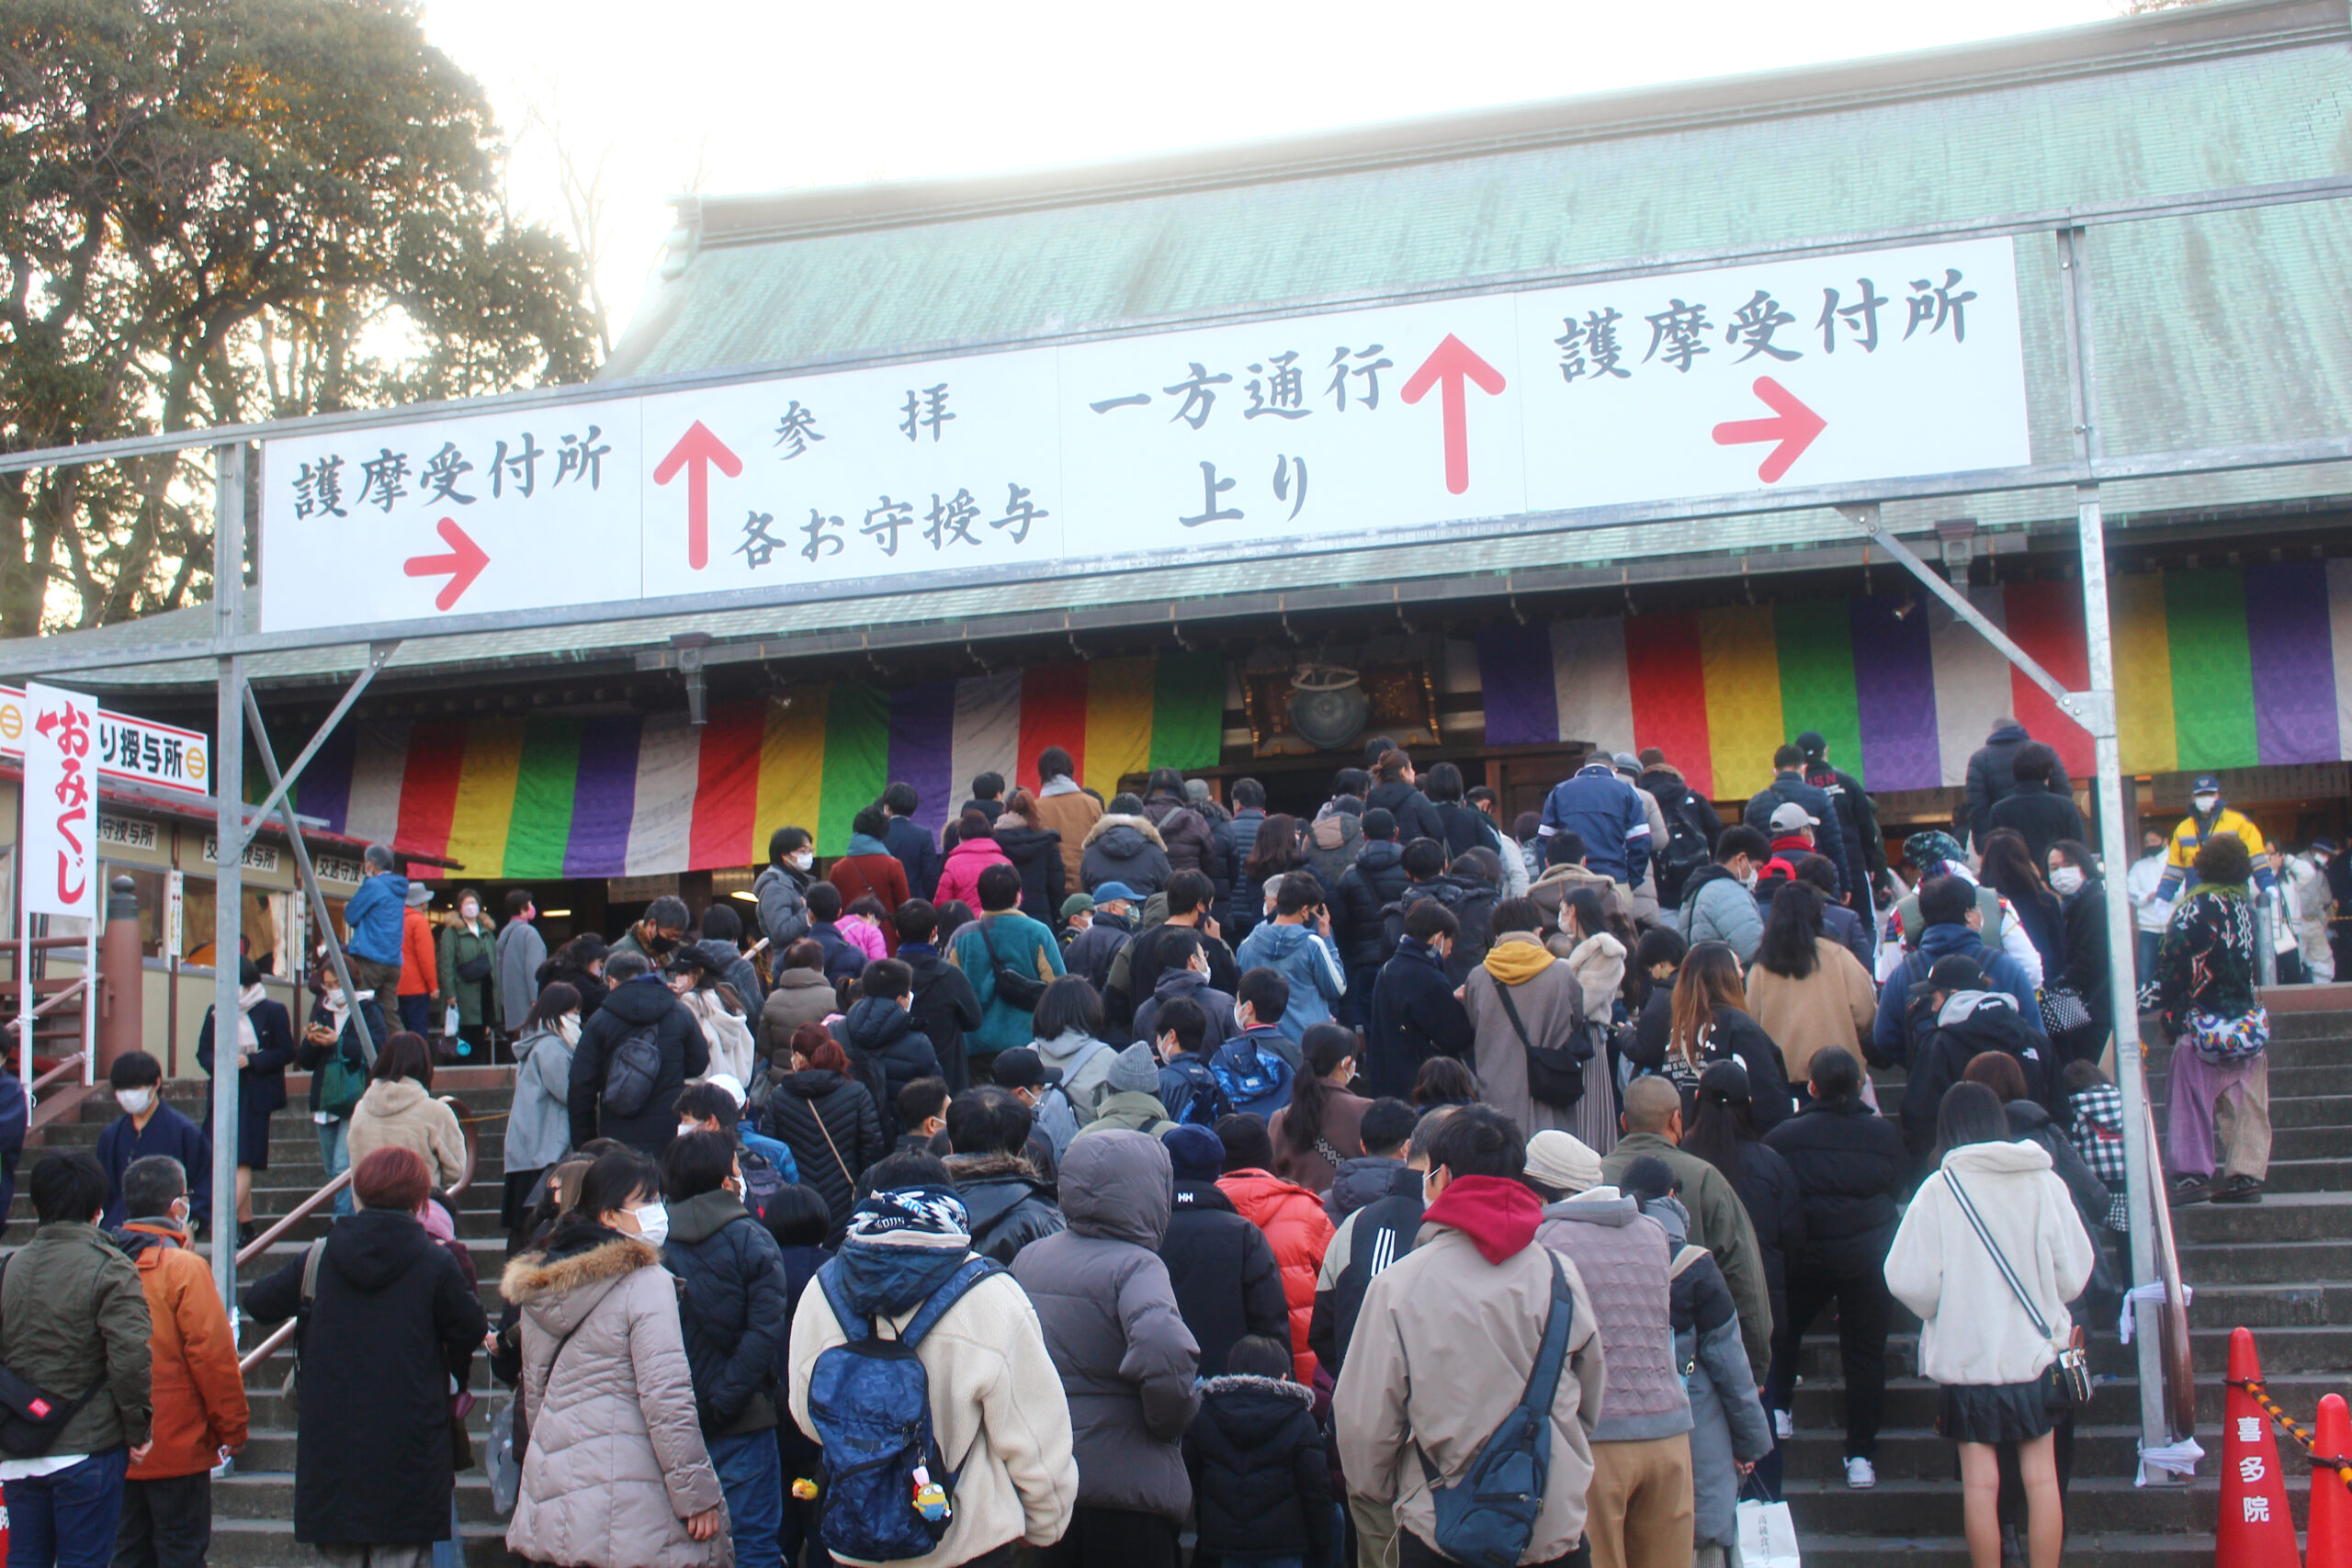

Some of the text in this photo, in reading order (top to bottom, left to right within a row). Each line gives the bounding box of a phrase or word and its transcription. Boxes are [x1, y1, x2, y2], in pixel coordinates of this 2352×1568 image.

[1553, 267, 1978, 383] 護摩受付所
[1088, 344, 1395, 431] 一方通行
[292, 424, 613, 522] 護摩受付所
[1178, 454, 1309, 529] 上り
[733, 482, 1050, 570] 各お守授与
[55, 701, 90, 905] おみくじ
[97, 817, 154, 847] 守授与所
[1178, 1192, 1193, 1203] HH
[2237, 1416, 2270, 1523] 喜多院
